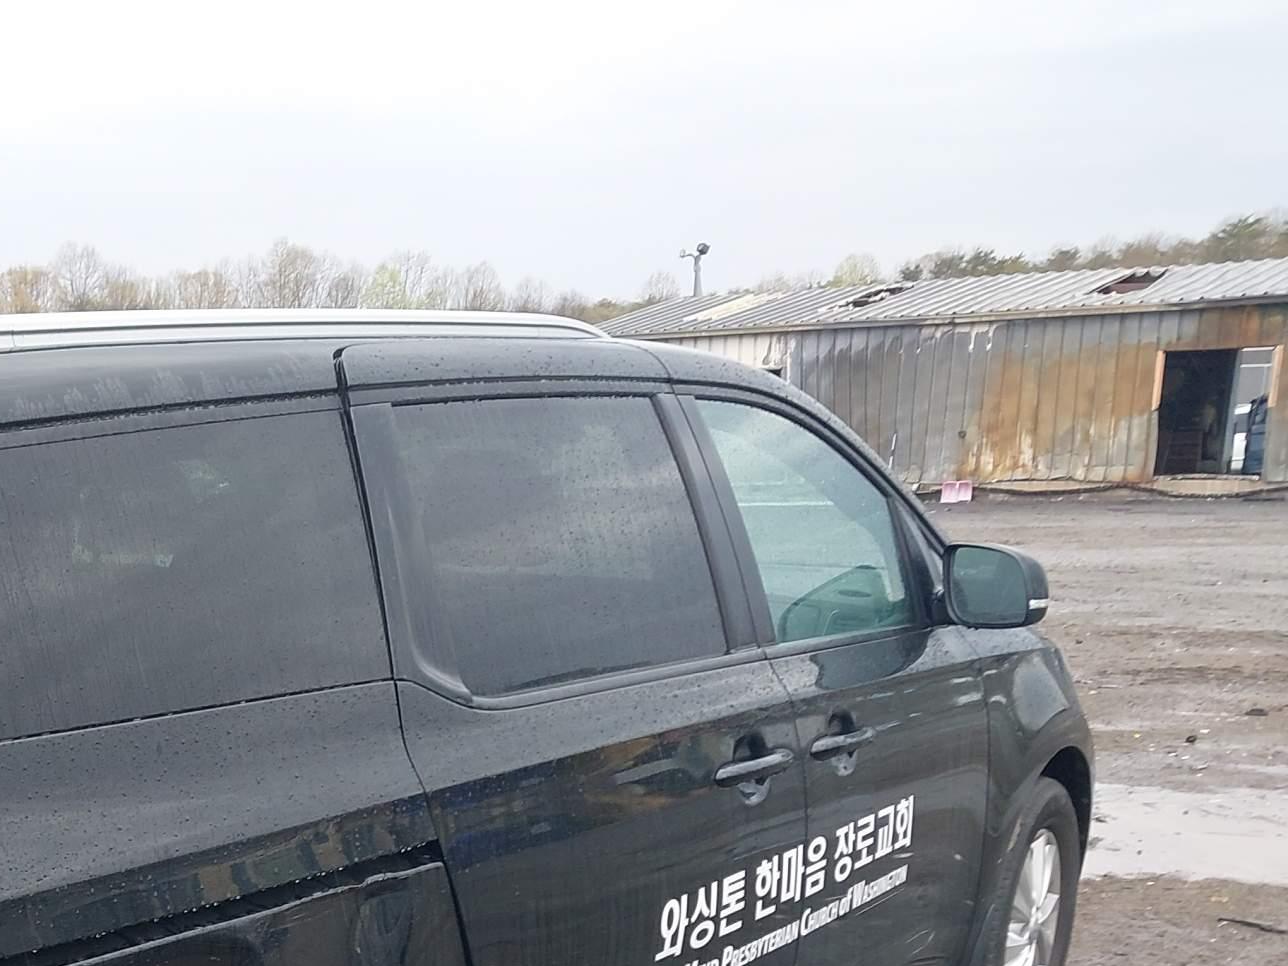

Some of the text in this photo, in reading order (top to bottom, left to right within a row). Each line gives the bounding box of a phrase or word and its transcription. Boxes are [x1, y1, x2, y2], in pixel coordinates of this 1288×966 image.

[654, 794, 915, 962] 와싱톤 한마음 장로교회
[838, 886, 853, 917] of
